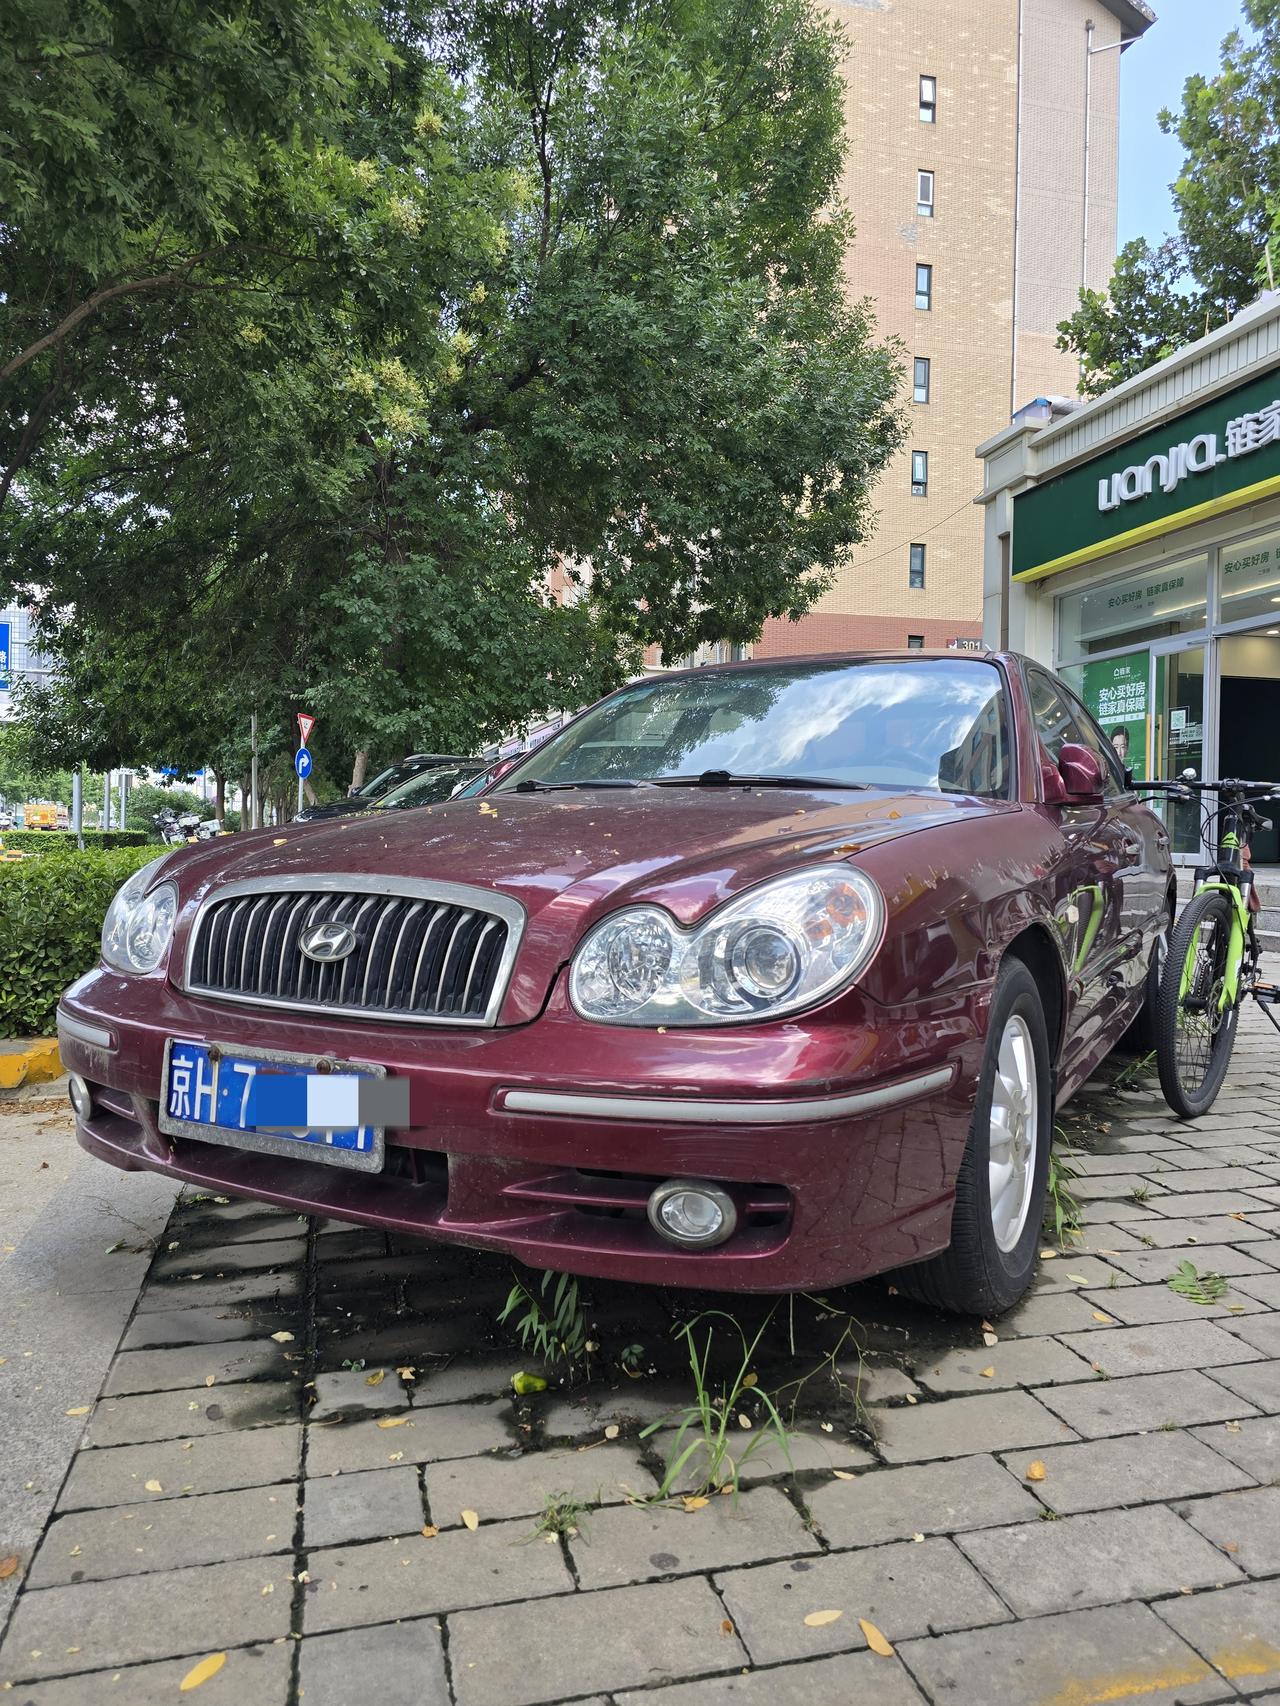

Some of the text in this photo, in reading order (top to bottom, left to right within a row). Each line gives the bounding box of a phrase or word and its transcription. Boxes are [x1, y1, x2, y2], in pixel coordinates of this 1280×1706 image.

[1224, 551, 1270, 575] 安心买好房
[962, 640, 981, 650] 301
[1099, 681, 1146, 702] 安心买好房
[1099, 696, 1146, 716] 链家真保障
